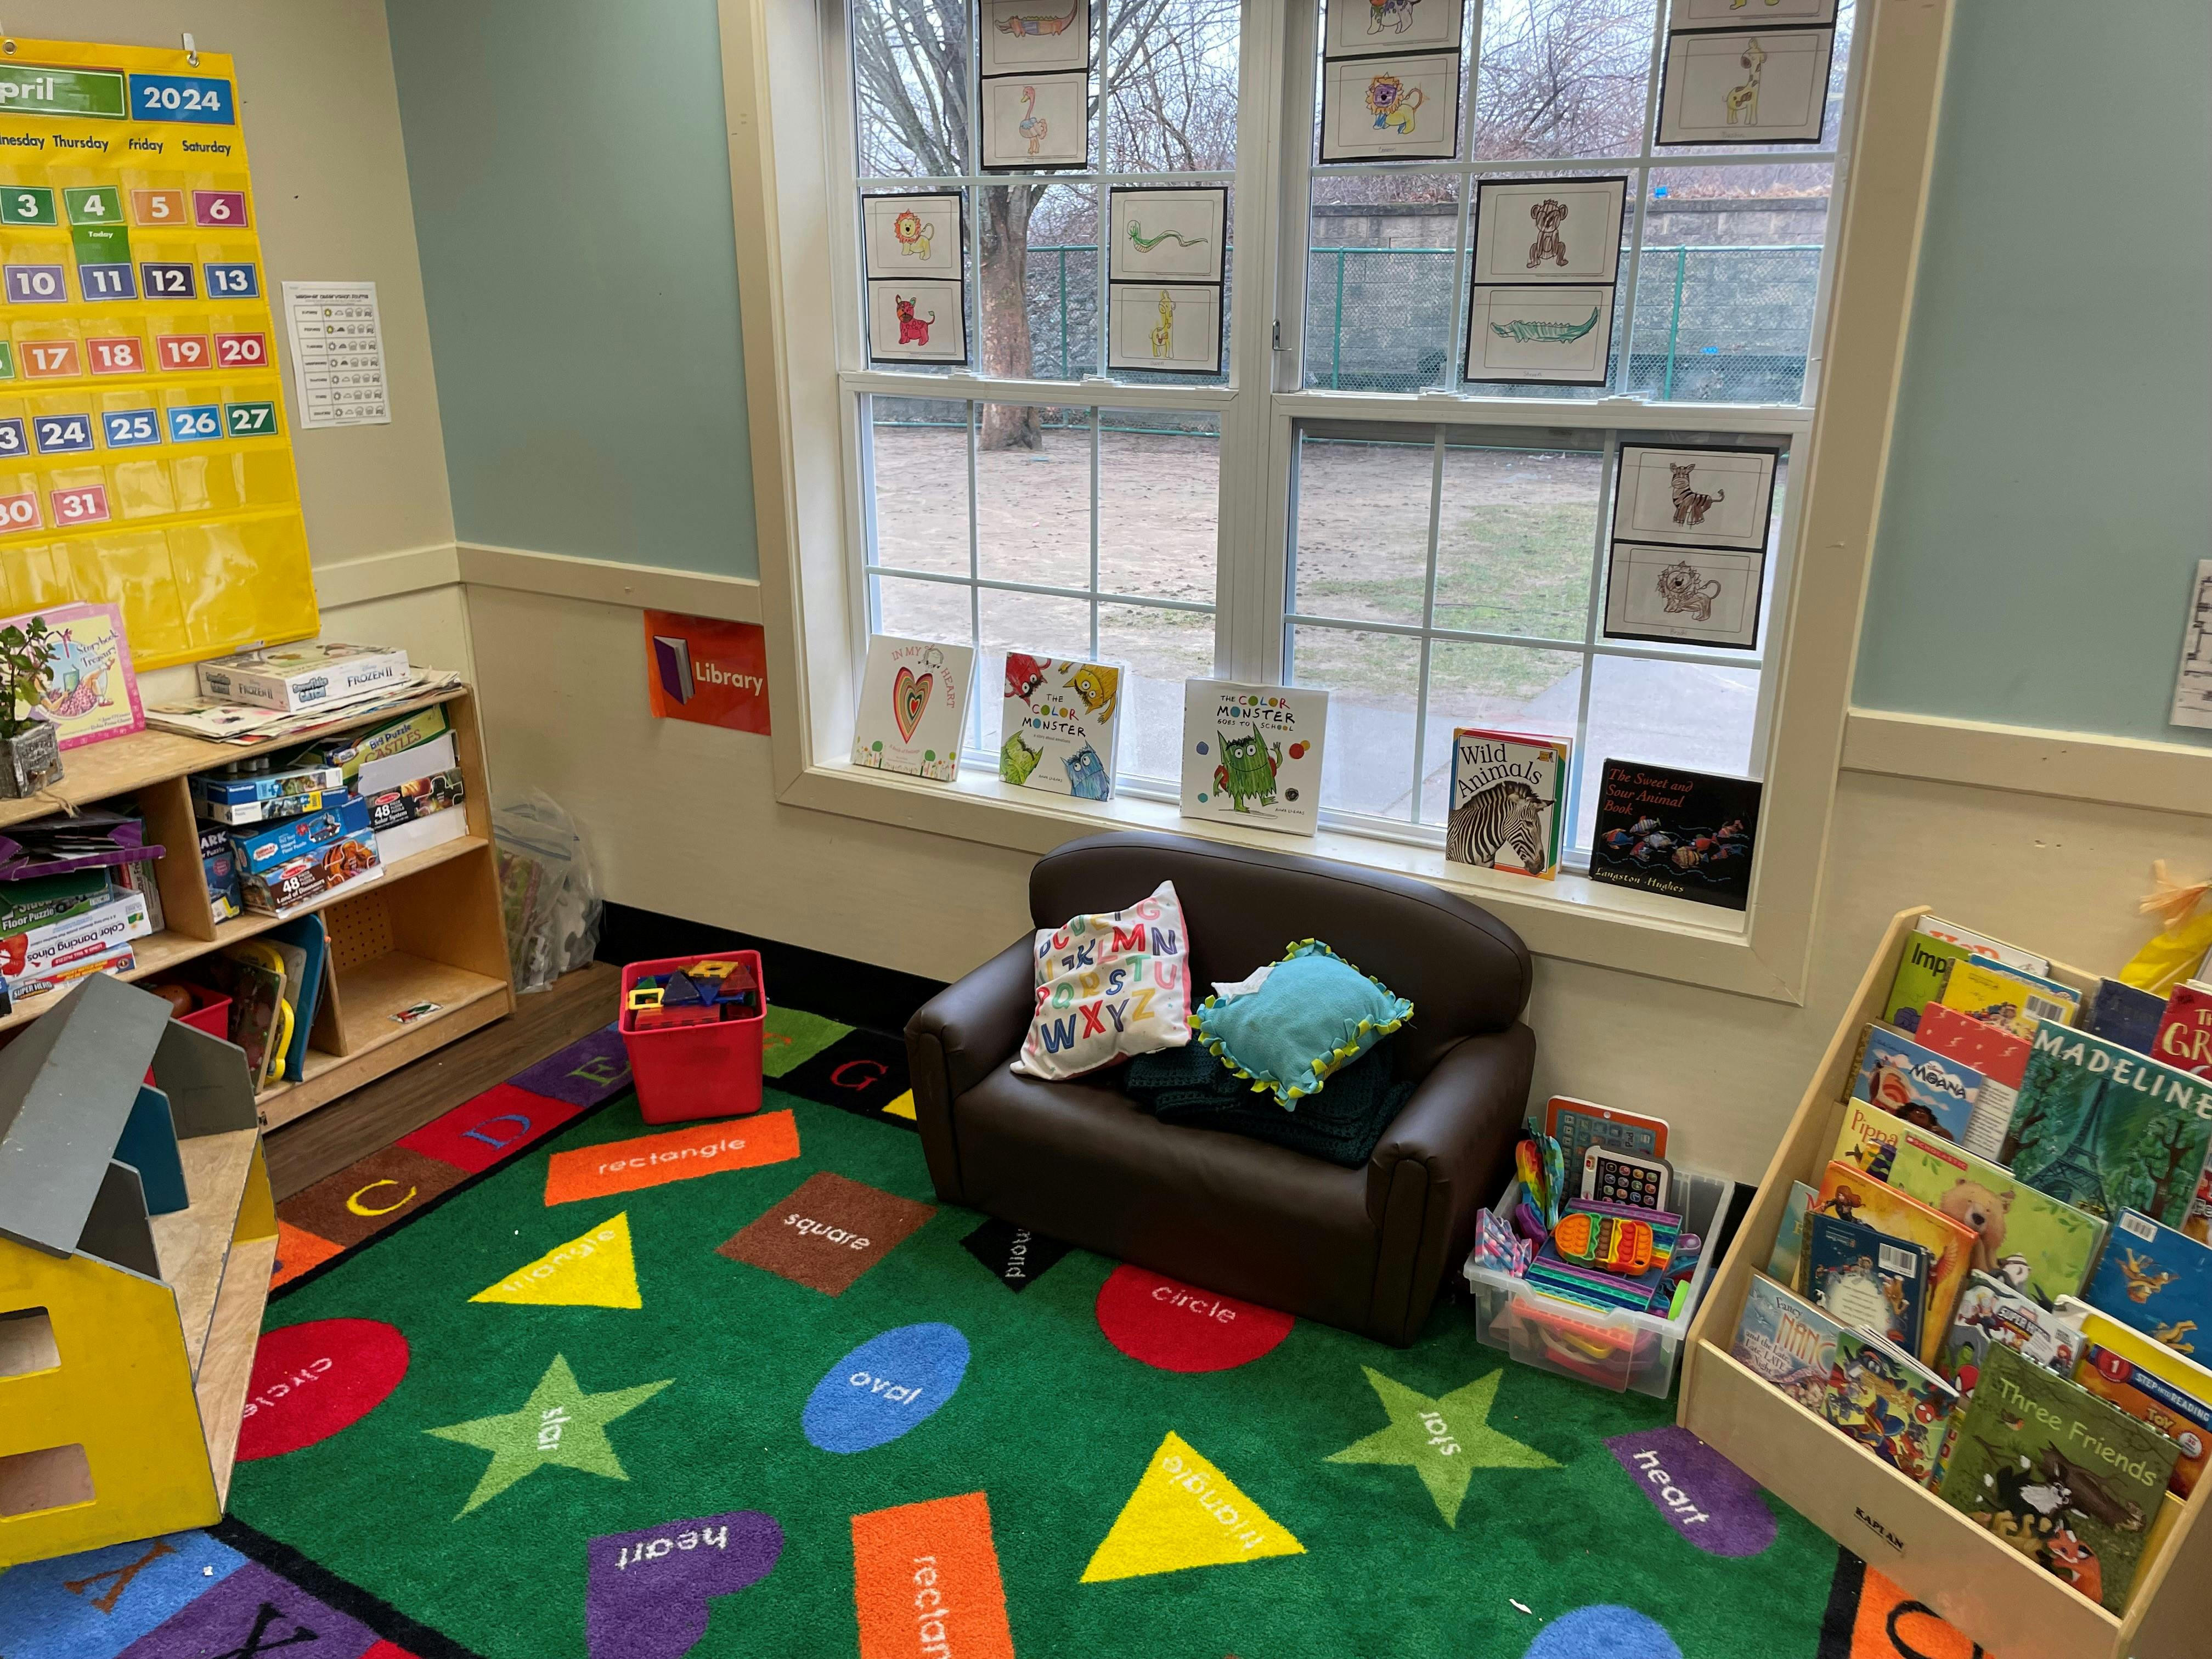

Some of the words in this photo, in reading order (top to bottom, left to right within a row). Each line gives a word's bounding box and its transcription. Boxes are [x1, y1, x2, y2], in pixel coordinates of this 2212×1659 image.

[0, 77, 53, 103] pril
[143, 87, 220, 111] 2024
[0, 134, 44, 151] nesday
[53, 136, 109, 152] Thursday
[128, 138, 163, 154] Friday
[182, 141, 231, 156] Saturday
[18, 194, 39, 217] 3
[83, 194, 105, 216] 4
[151, 196, 170, 218] 5
[210, 199, 230, 220] 6
[16, 272, 56, 294] 10
[92, 271, 122, 292] 11
[151, 270, 187, 291] 12
[215, 270, 249, 290] 13
[32, 348, 69, 370] 17
[98, 344, 134, 367] 18
[167, 341, 201, 363] 19
[222, 340, 261, 360] 20
[111, 416, 153, 439] 25
[175, 413, 216, 435] 26
[231, 408, 269, 430] 27
[41, 422, 85, 445] 24
[63, 493, 96, 517] 31
[77, 629, 119, 654] Storybook
[81, 645, 116, 667] Treasury
[891, 649, 902, 661] IN
[905, 647, 922, 656] MY
[347, 670, 385, 687] FROZEN
[386, 666, 393, 677] II
[696, 662, 763, 696] Library
[941, 667, 955, 708] HEART
[1046, 693, 1063, 702] THE
[1239, 696, 1290, 709] COLOR
[1032, 704, 1079, 721] COLOR
[1217, 706, 1295, 724] MONSTER
[369, 739, 383, 751] Big
[385, 724, 412, 742] Puzzle
[1022, 717, 1086, 737] MONSTER
[1261, 723, 1294, 731] SCHOOL
[364, 729, 422, 763] CASTLES
[1460, 743, 1508, 765] Wild
[1458, 761, 1543, 799] Animals
[1609, 769, 1630, 782] The
[1634, 773, 1668, 789] Sweet
[1671, 781, 1694, 792] and
[1604, 800, 1633, 815] Book
[1606, 785, 1635, 799] Sour
[1635, 790, 1686, 808] Animal
[374, 805, 391, 819] 48
[201, 831, 227, 848] ARK
[283, 877, 300, 892] 48
[1595, 867, 1640, 884] Langston
[1645, 878, 1685, 893] Hughes
[2, 918, 29, 930] Floor
[29, 908, 54, 923] Puzzle
[1137, 896, 1161, 921] G
[57, 932, 99, 951] Dancing
[100, 923, 125, 937] Color
[1112, 923, 1146, 953] M
[1151, 927, 1178, 956] N
[27, 947, 56, 962] Dinos
[1911, 943, 1947, 977] Imp
[1052, 982, 1074, 1009] Q
[1079, 971, 1100, 998] R
[1105, 969, 1126, 996] S
[1125, 955, 1151, 981] T
[1154, 961, 1177, 990] U
[1041, 1013, 1077, 1053] W
[1079, 1000, 1107, 1039] X
[1105, 998, 1130, 1032] Y
[1131, 988, 1156, 1022] Z
[830, 1060, 887, 1091] G
[1908, 1064, 1966, 1099] MOANA
[2034, 1029, 2212, 1120] MADELINE
[460, 1114, 532, 1150] D
[1851, 1109, 1898, 1147] Pippa
[598, 1136, 746, 1175] rectangle
[1913, 1140, 1967, 1170] SCHOLASTIC
[346, 1179, 417, 1216] C
[783, 1211, 871, 1251] square
[503, 1228, 616, 1291] triangle
[1151, 1284, 1237, 1324] circle
[1776, 1297, 1803, 1319] Fancy
[1746, 1331, 1760, 1342] and
[1760, 1337, 1773, 1350] the
[1755, 1355, 1774, 1374] Night
[2112, 1360, 2120, 1374] 1
[243, 1357, 333, 1419] circle
[849, 1370, 923, 1406] oval
[2135, 1373, 2158, 1389] STEP
[2171, 1393, 2210, 1421] READING
[538, 1406, 572, 1452] star
[2147, 1408, 2175, 1429] TOY
[1419, 1410, 1461, 1458] star
[2001, 1377, 2063, 1431] Three
[2068, 1419, 2158, 1487] Friends
[1633, 1448, 1711, 1527] heart
[1163, 1454, 1266, 1555] triangle
[1855, 1506, 1904, 1549] KAPLAN
[614, 1525, 730, 1571] heart
[64, 1541, 177, 1615] Y
